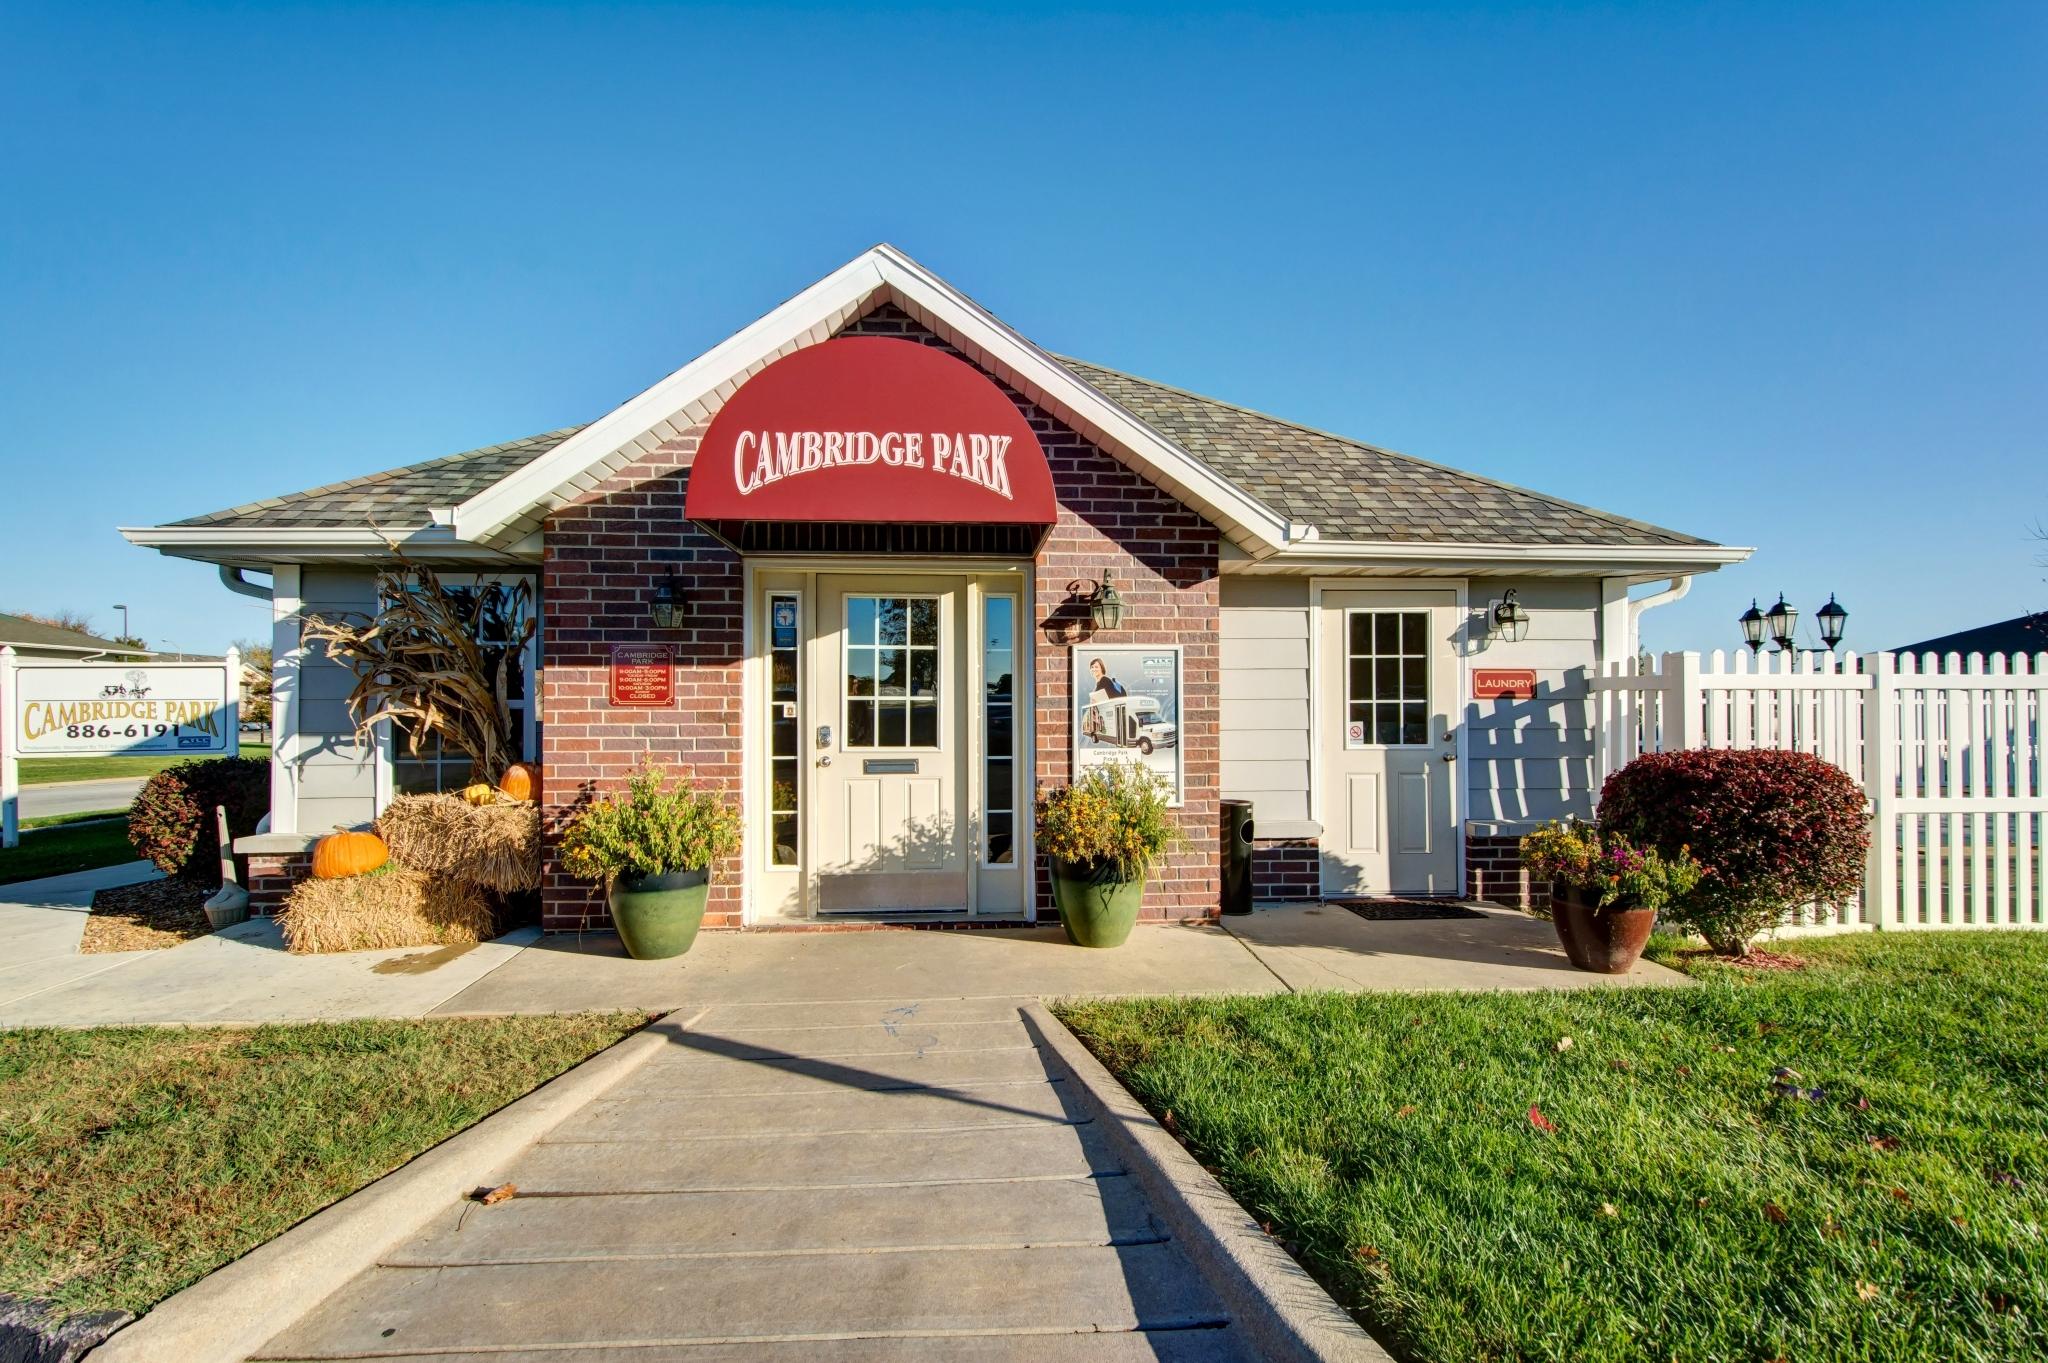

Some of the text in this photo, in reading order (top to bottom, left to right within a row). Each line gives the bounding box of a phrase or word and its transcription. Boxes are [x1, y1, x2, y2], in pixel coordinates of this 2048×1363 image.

[734, 430, 1014, 500] CAMBRIDGE PARK
[1477, 679, 1532, 688] LAUNDRY
[24, 700, 219, 740] CAMBRIDGE PARK
[66, 723, 180, 739] 886-6191
